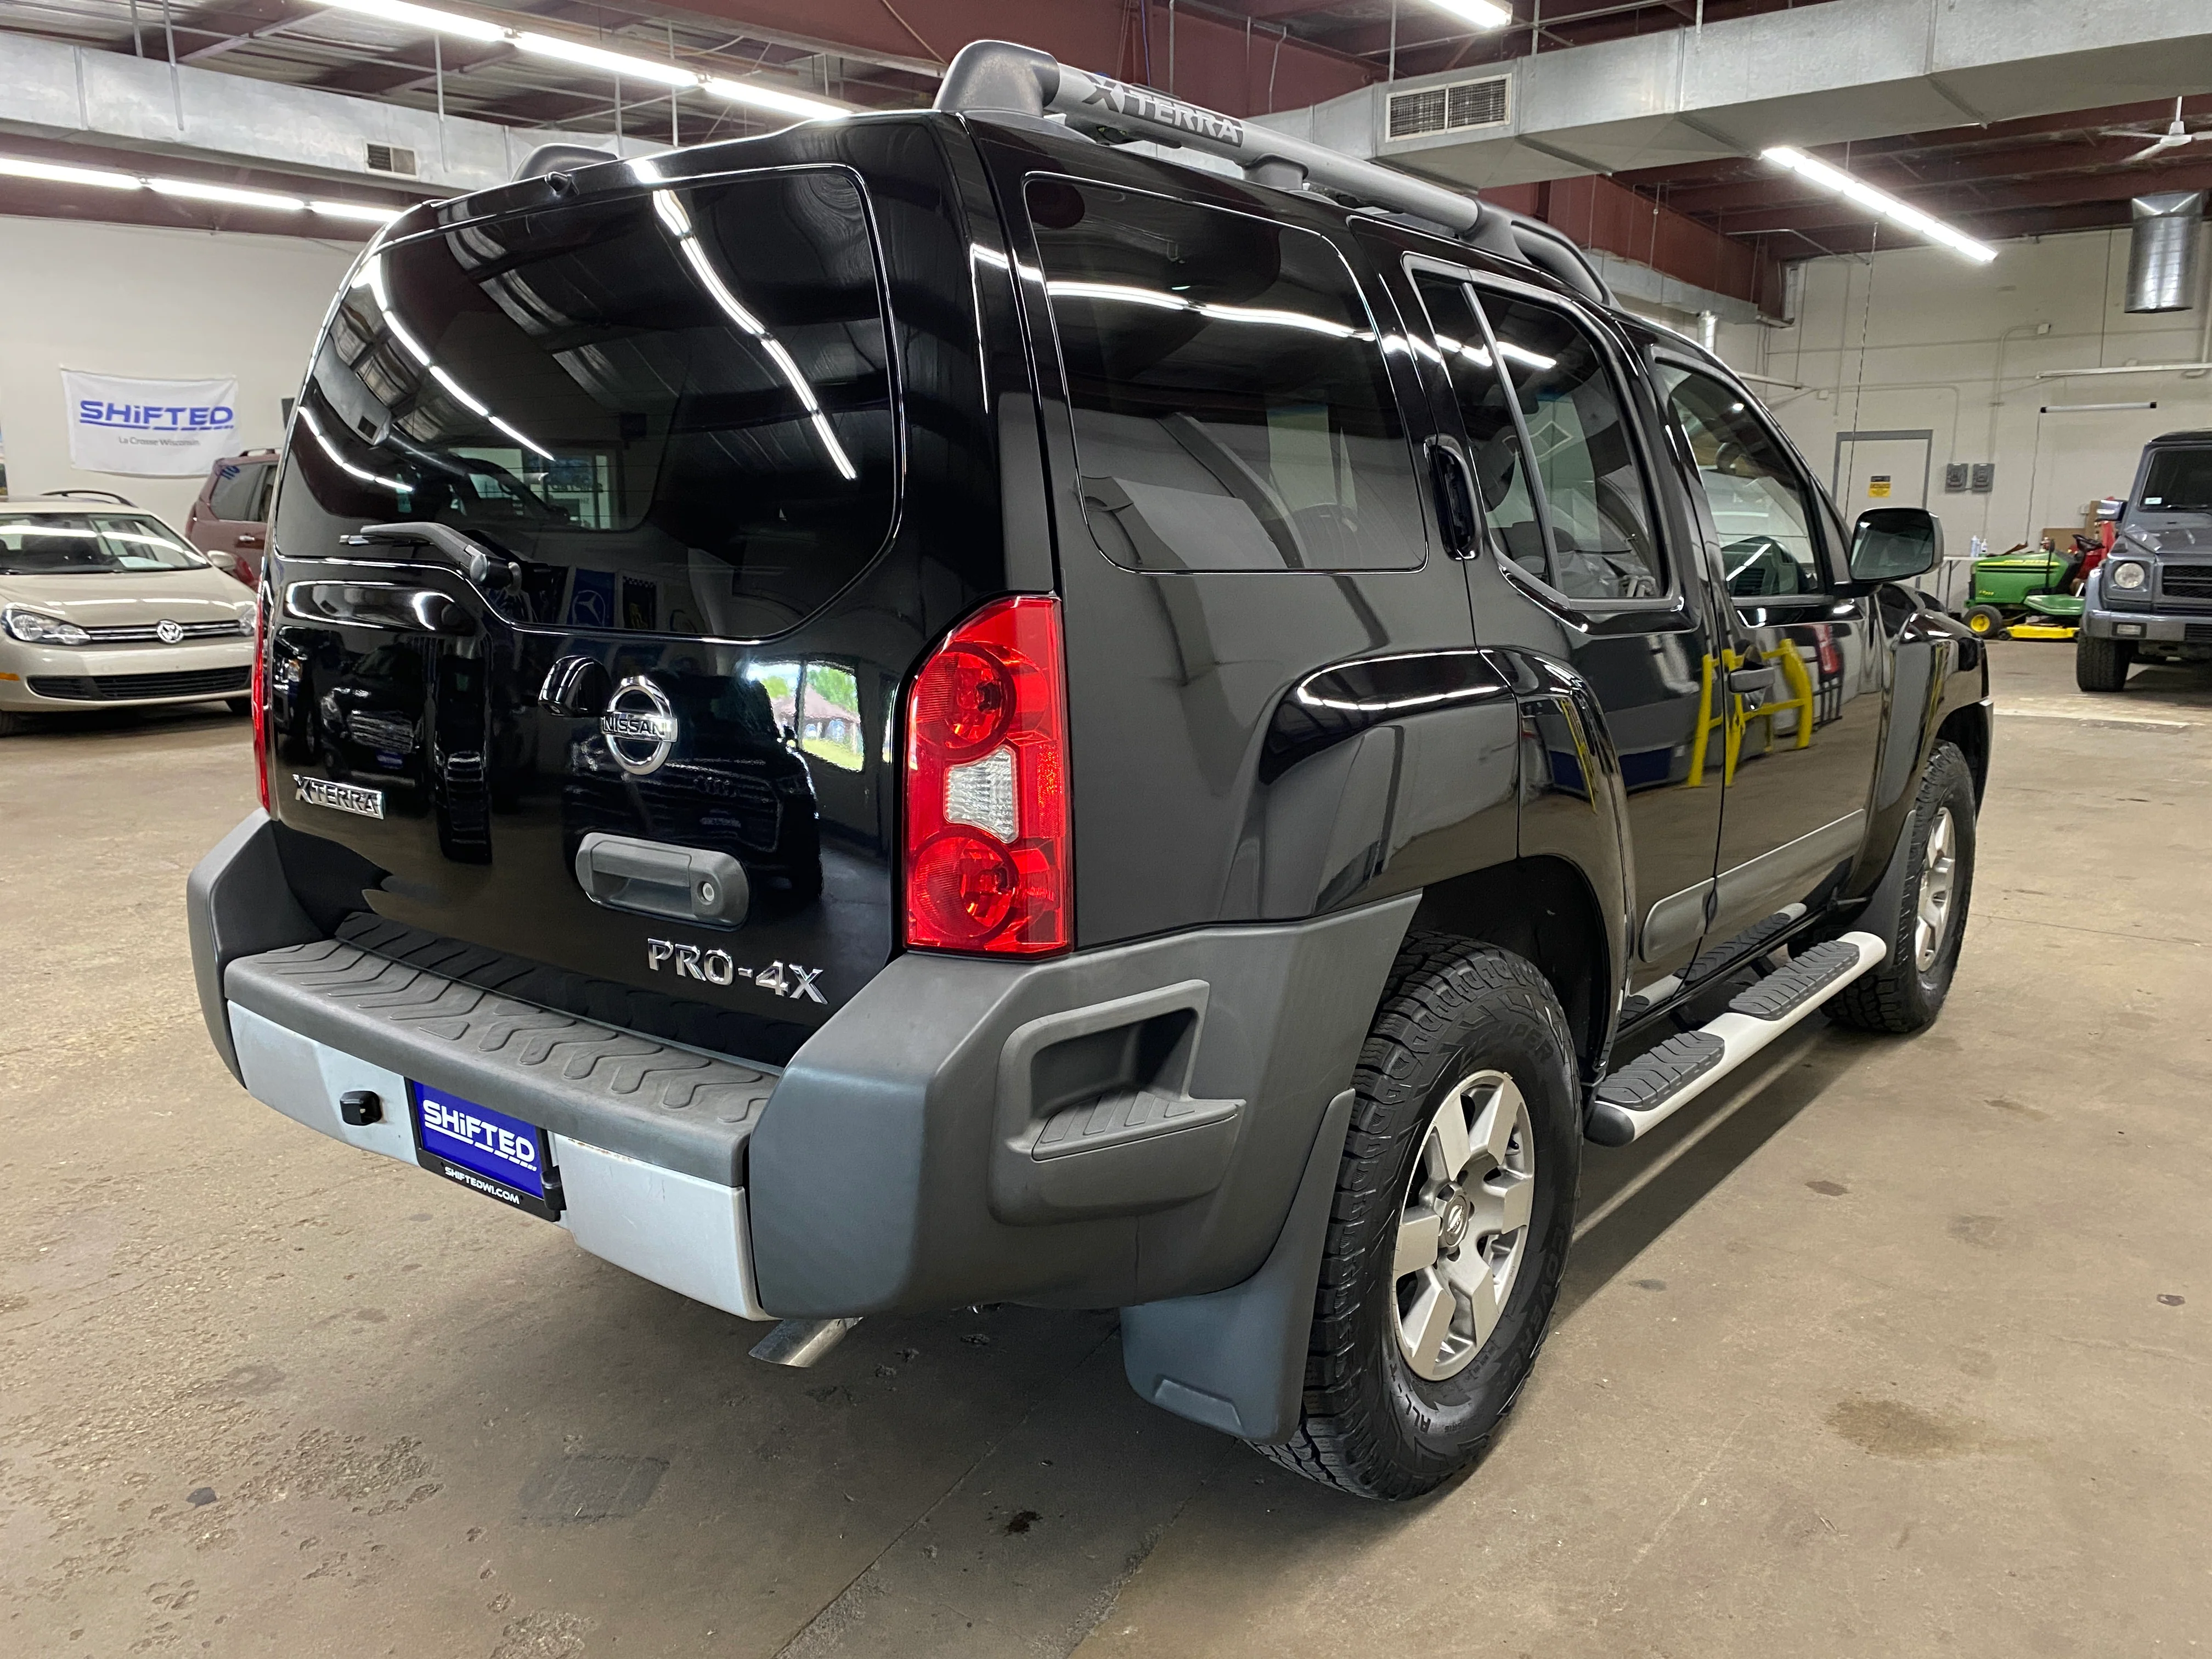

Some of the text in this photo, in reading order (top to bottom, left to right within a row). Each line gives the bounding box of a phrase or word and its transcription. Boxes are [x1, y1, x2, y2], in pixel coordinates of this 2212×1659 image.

[1082, 73, 1243, 147] XTERRA
[130, 437, 159, 445] Crosse
[603, 715, 672, 740] NISSAN
[292, 774, 383, 820] XTERRA
[647, 937, 828, 1005] PRO-4X
[444, 1166, 520, 1205] SHIFTEDWI.COM
